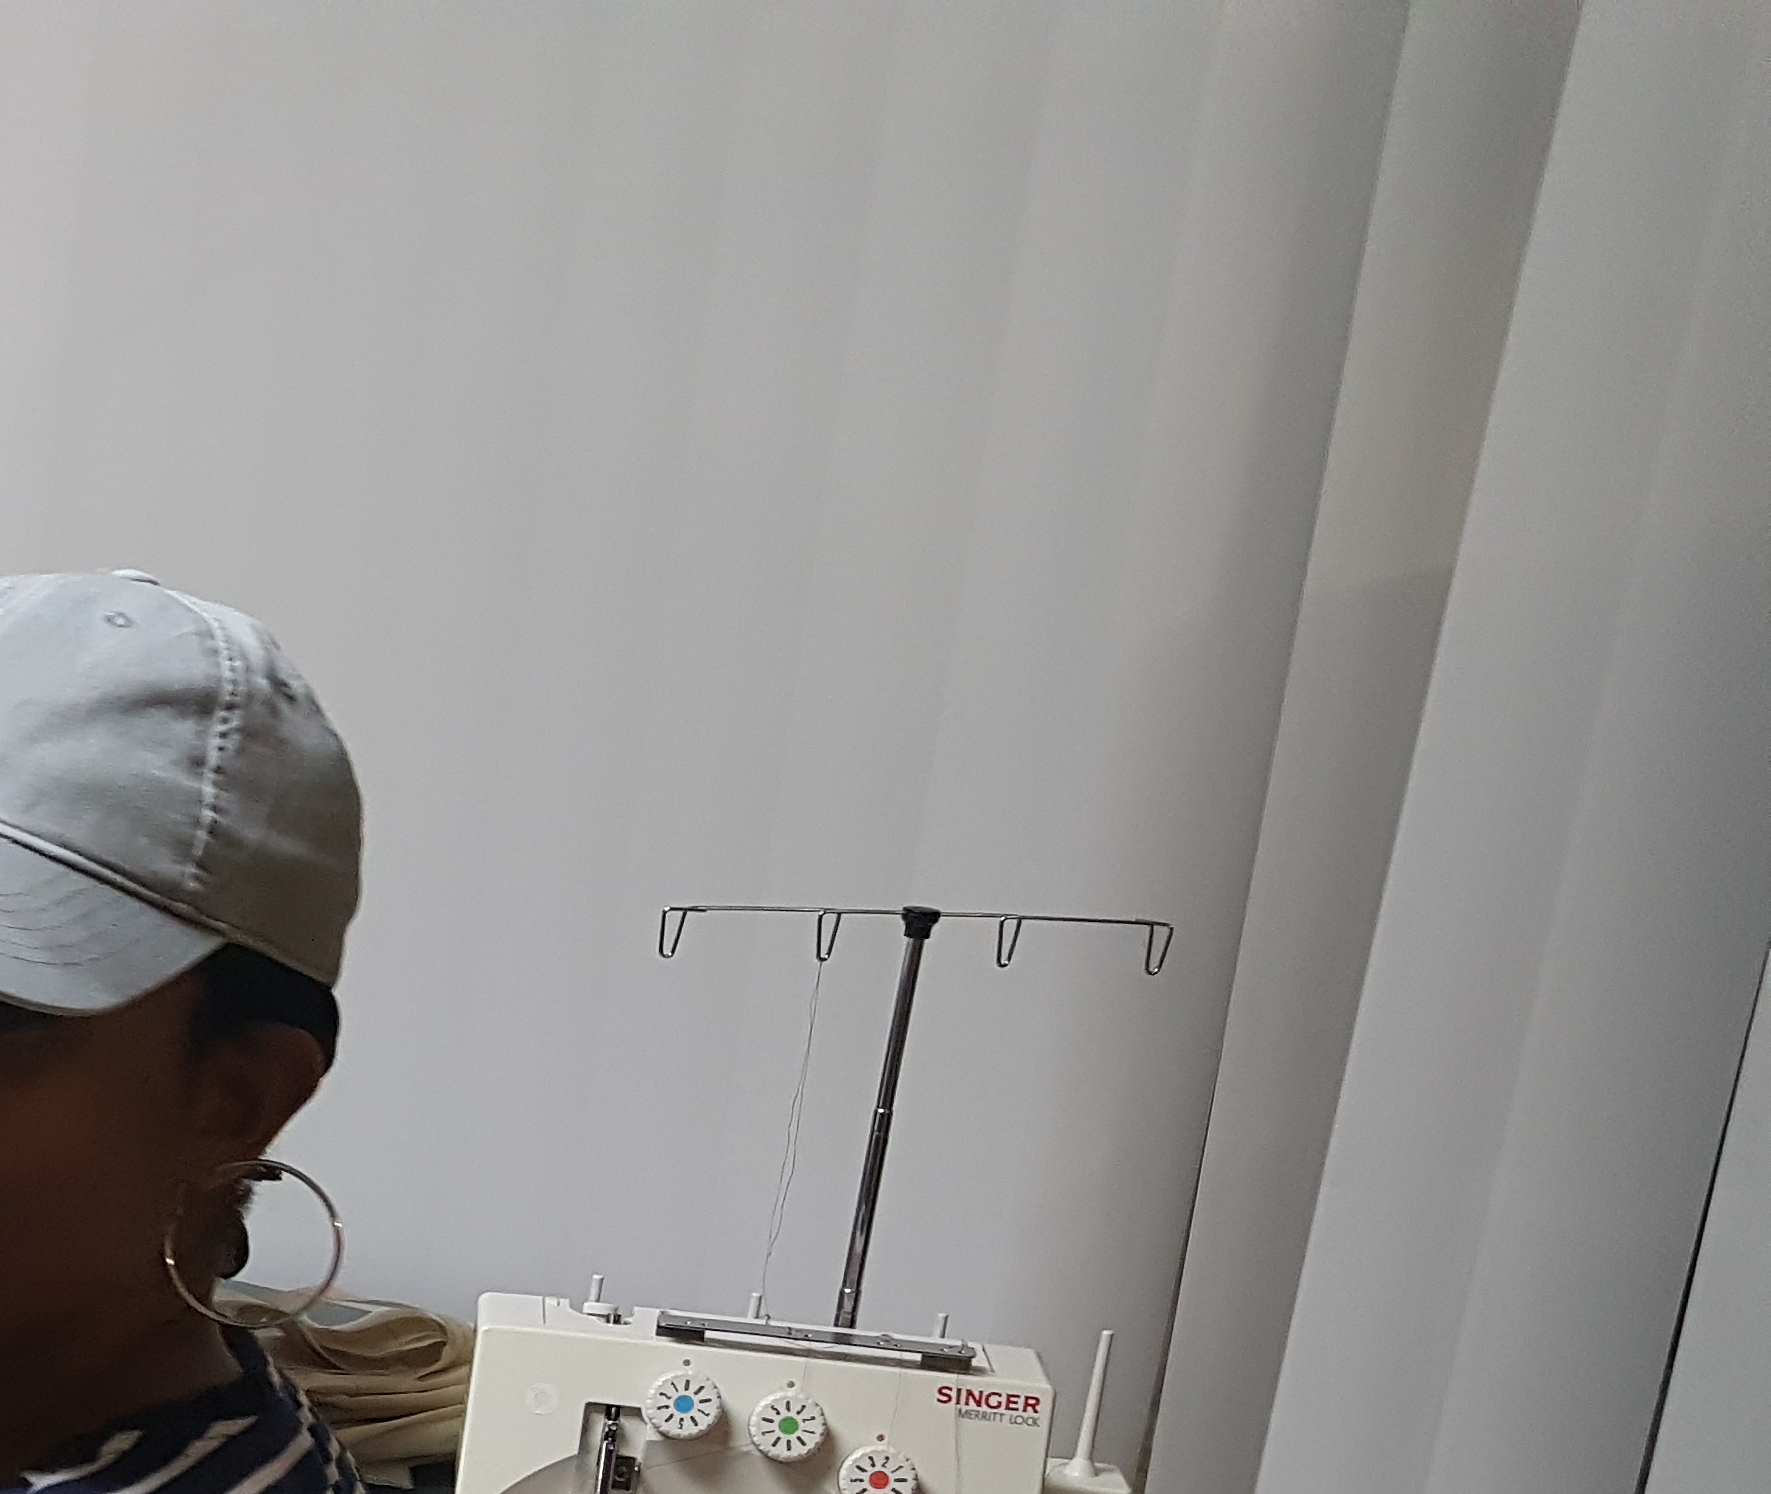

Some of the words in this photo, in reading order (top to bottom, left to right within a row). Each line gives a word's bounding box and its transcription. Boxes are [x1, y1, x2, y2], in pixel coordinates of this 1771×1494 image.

[936, 1385, 1041, 1414] SINGER
[957, 1407, 1004, 1424] MERRITT
[1009, 1411, 1042, 1427] LOCK
